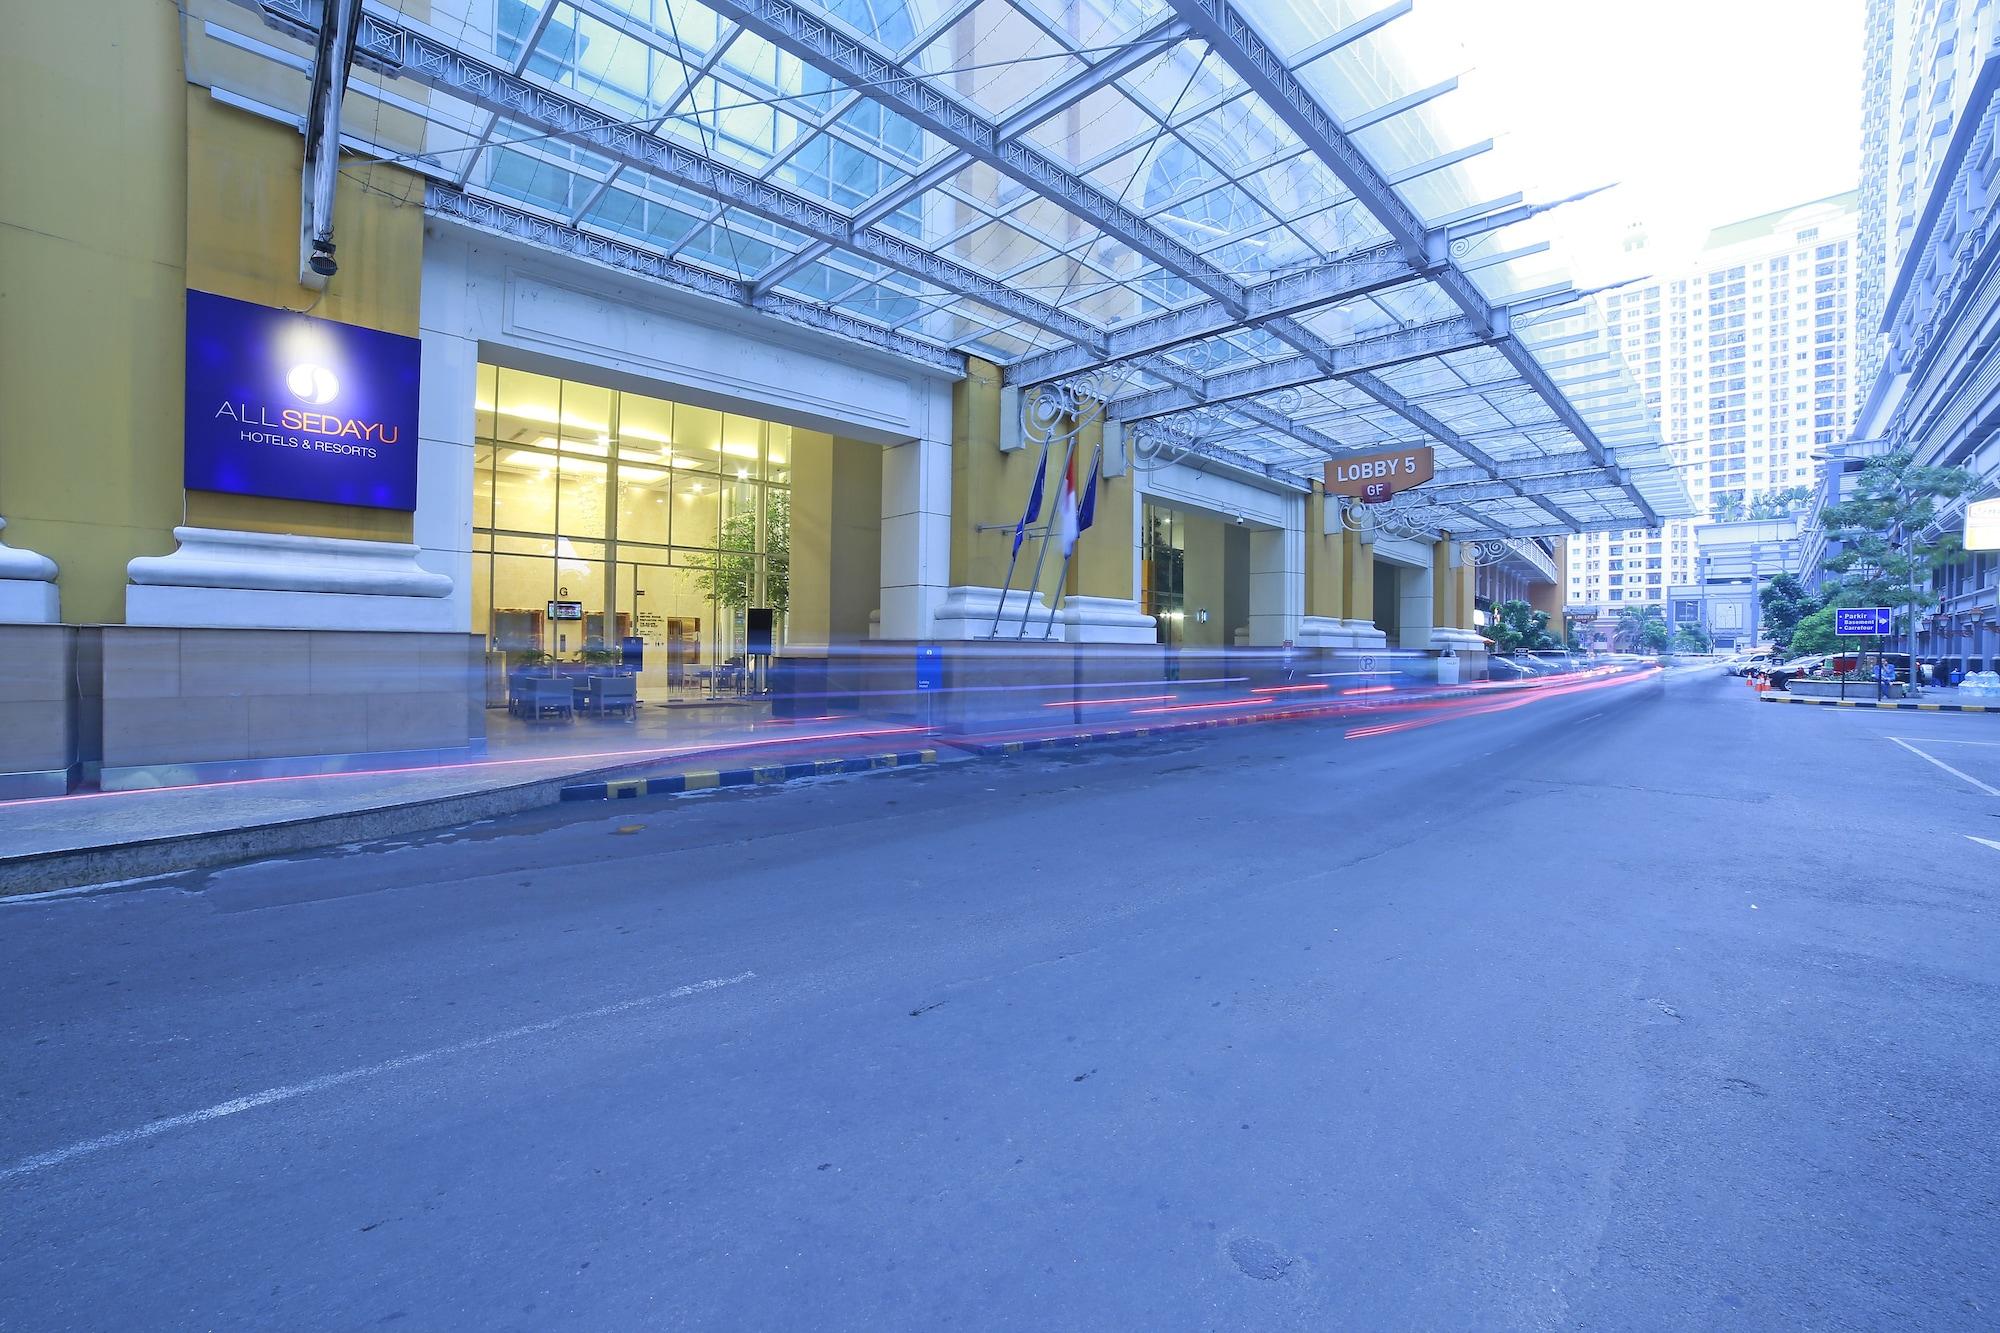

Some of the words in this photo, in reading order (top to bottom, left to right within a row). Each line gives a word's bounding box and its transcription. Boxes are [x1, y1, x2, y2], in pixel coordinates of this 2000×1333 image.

[215, 401, 279, 428] ALL
[281, 409, 399, 444] SEDAYU
[240, 431, 298, 448] HOTELS
[302, 439, 311, 450] &
[315, 441, 377, 458] RESORTS
[1337, 458, 1399, 482] LOBBY
[1405, 456, 1416, 474] 5
[1367, 483, 1384, 496] GF
[559, 586, 568, 597] G
